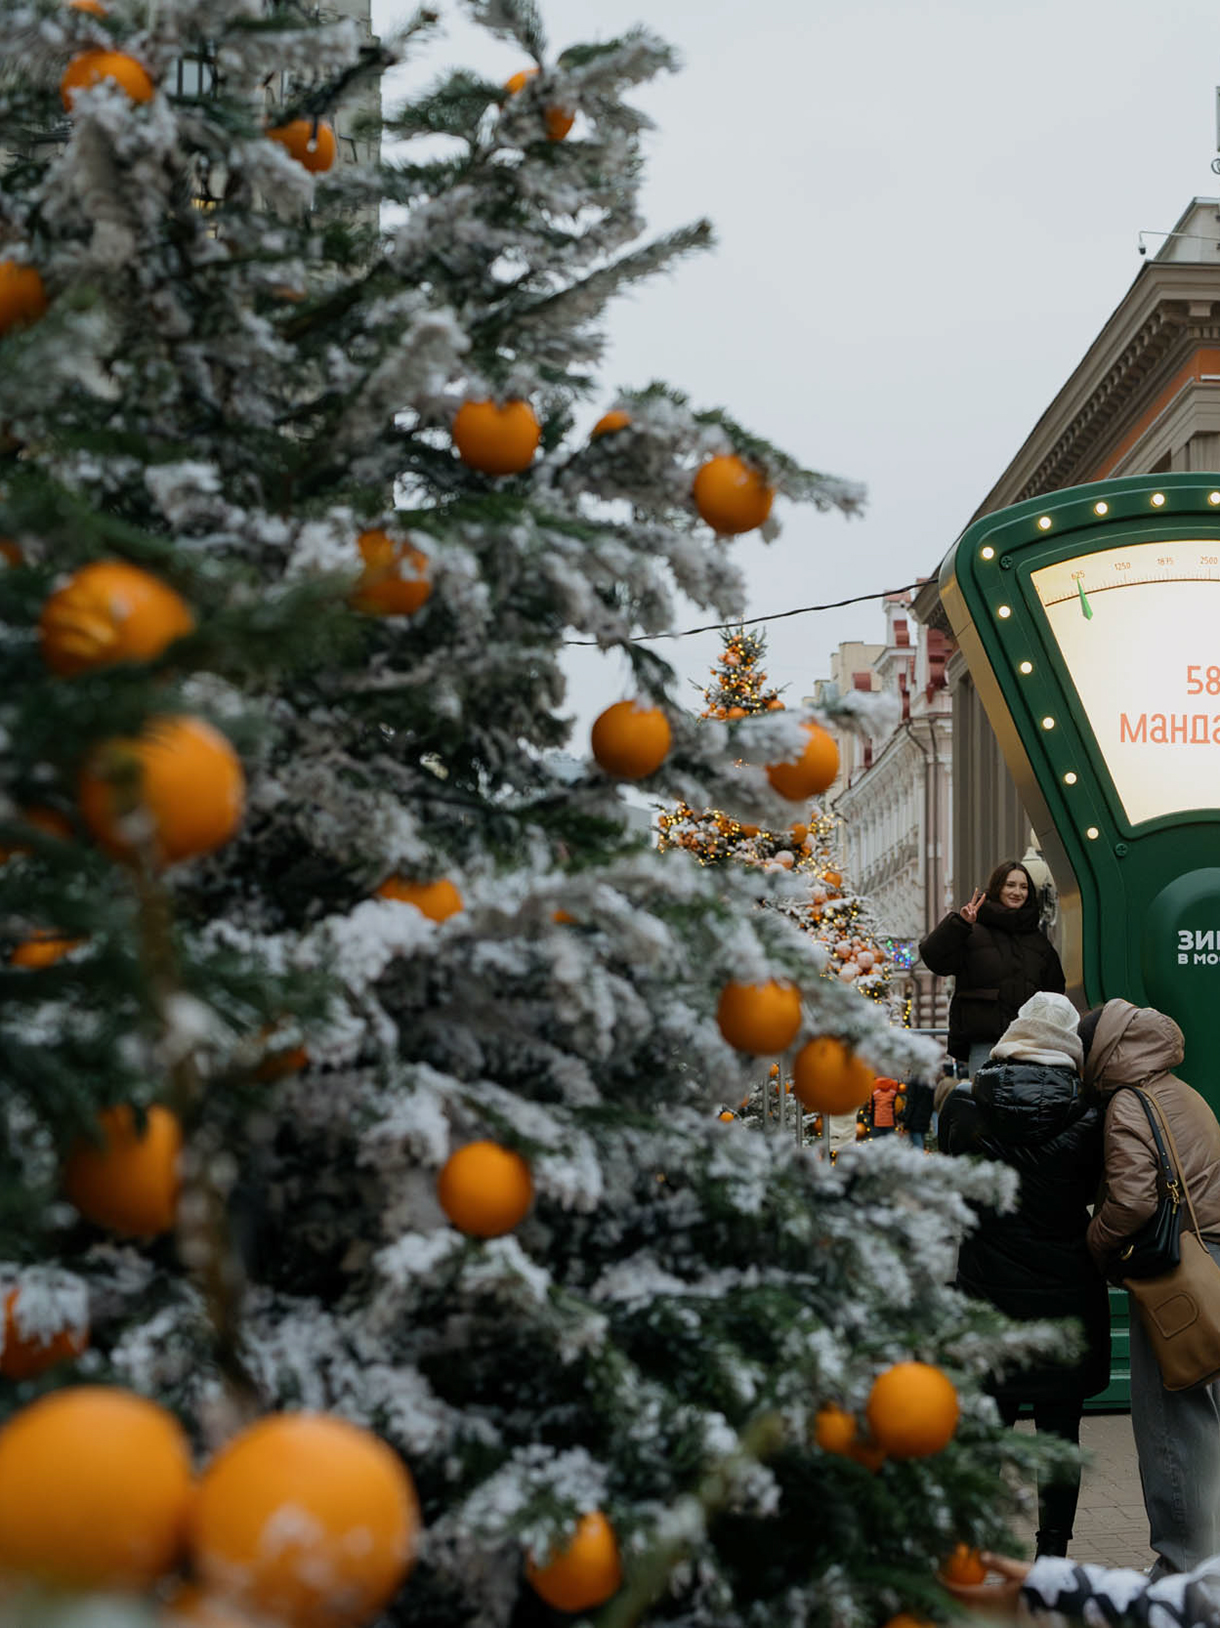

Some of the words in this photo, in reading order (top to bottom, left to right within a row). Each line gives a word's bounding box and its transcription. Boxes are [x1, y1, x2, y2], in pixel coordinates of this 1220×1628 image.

[1114, 562, 1131, 571] 1250
[1200, 556, 1218, 565] 2500
[1177, 953, 1189, 965] В
